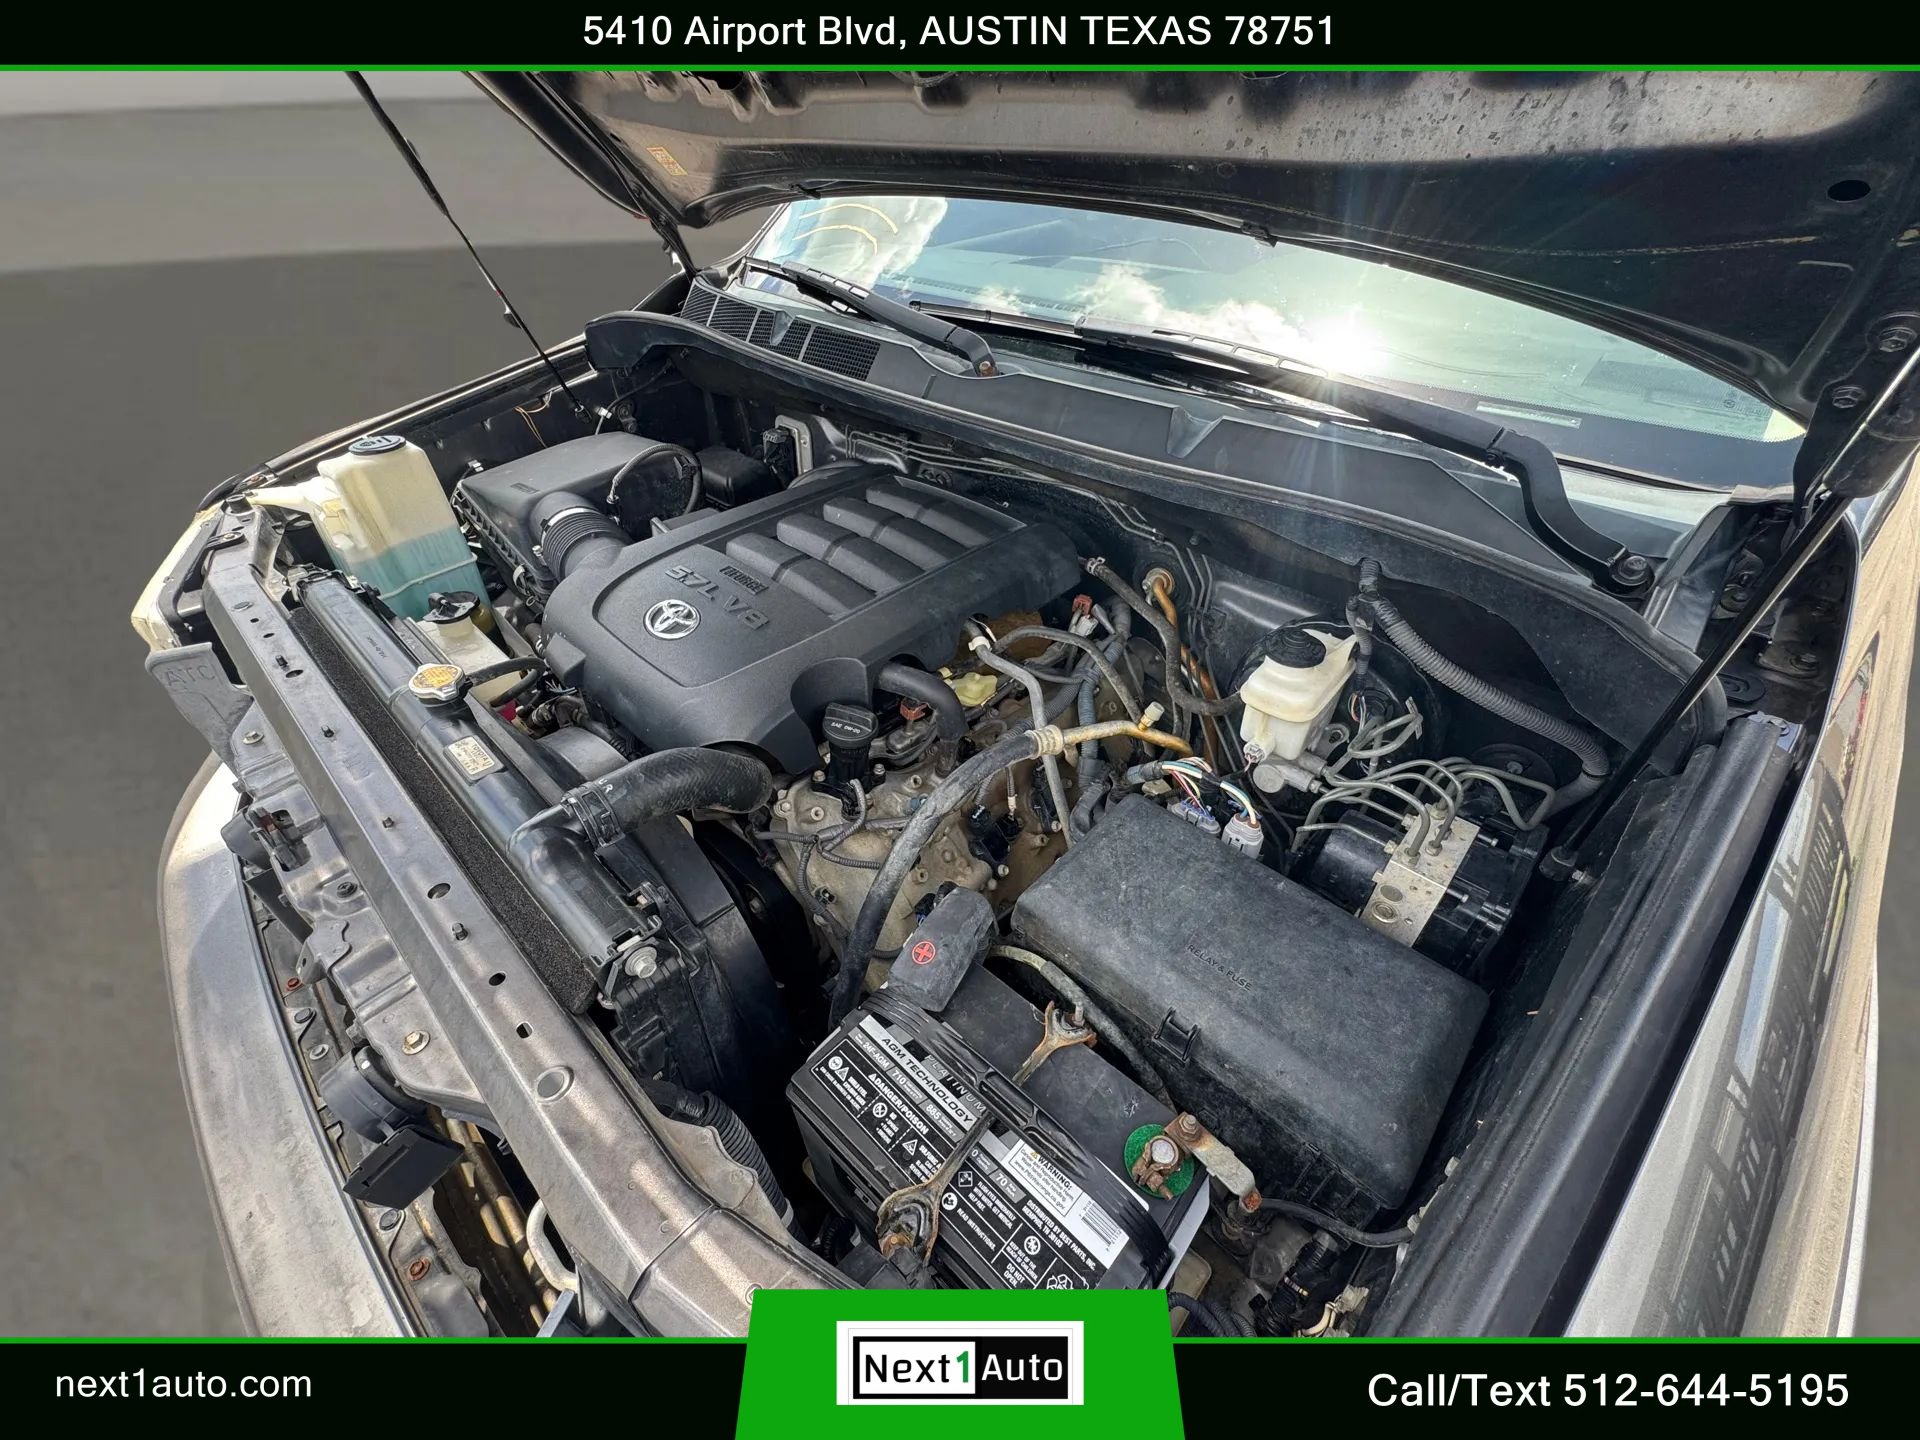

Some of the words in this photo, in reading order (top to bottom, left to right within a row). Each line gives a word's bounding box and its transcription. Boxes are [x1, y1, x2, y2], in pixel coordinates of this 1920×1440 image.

[1187, 944, 1217, 967] RELAY
[1225, 970, 1254, 992] FUSE
[861, 1041, 889, 1069] 24F-AGM
[881, 1035, 906, 1060] AGM
[905, 1058, 973, 1125] TECHNOLOGY
[891, 1069, 907, 1085] 710
[923, 1053, 987, 1114] PLATINUM
[872, 1076, 930, 1135] DANGER/POISON
[925, 1103, 941, 1120] 885
[994, 1172, 1008, 1187] 70
[1036, 1155, 1074, 1191] WARNING:
[955, 1207, 969, 1221] READ
[965, 1218, 998, 1251] INSTRUCTIONS.
[1020, 1205, 1044, 1229] MEMPHIS,
[1041, 1225, 1051, 1235] TN
[1047, 1231, 1063, 1248] 38103
[1025, 1199, 1055, 1229] DISTRIBUTED
[1051, 1225, 1061, 1235] BY
[1057, 1231, 1072, 1246] BEST
[1069, 1242, 1088, 1262] PARTS,
[1084, 1257, 1097, 1271] INC.
[1002, 1270, 1019, 1287] OPEN.
[1005, 1262, 1016, 1274] DO
[1012, 1270, 1025, 1284] NOT
